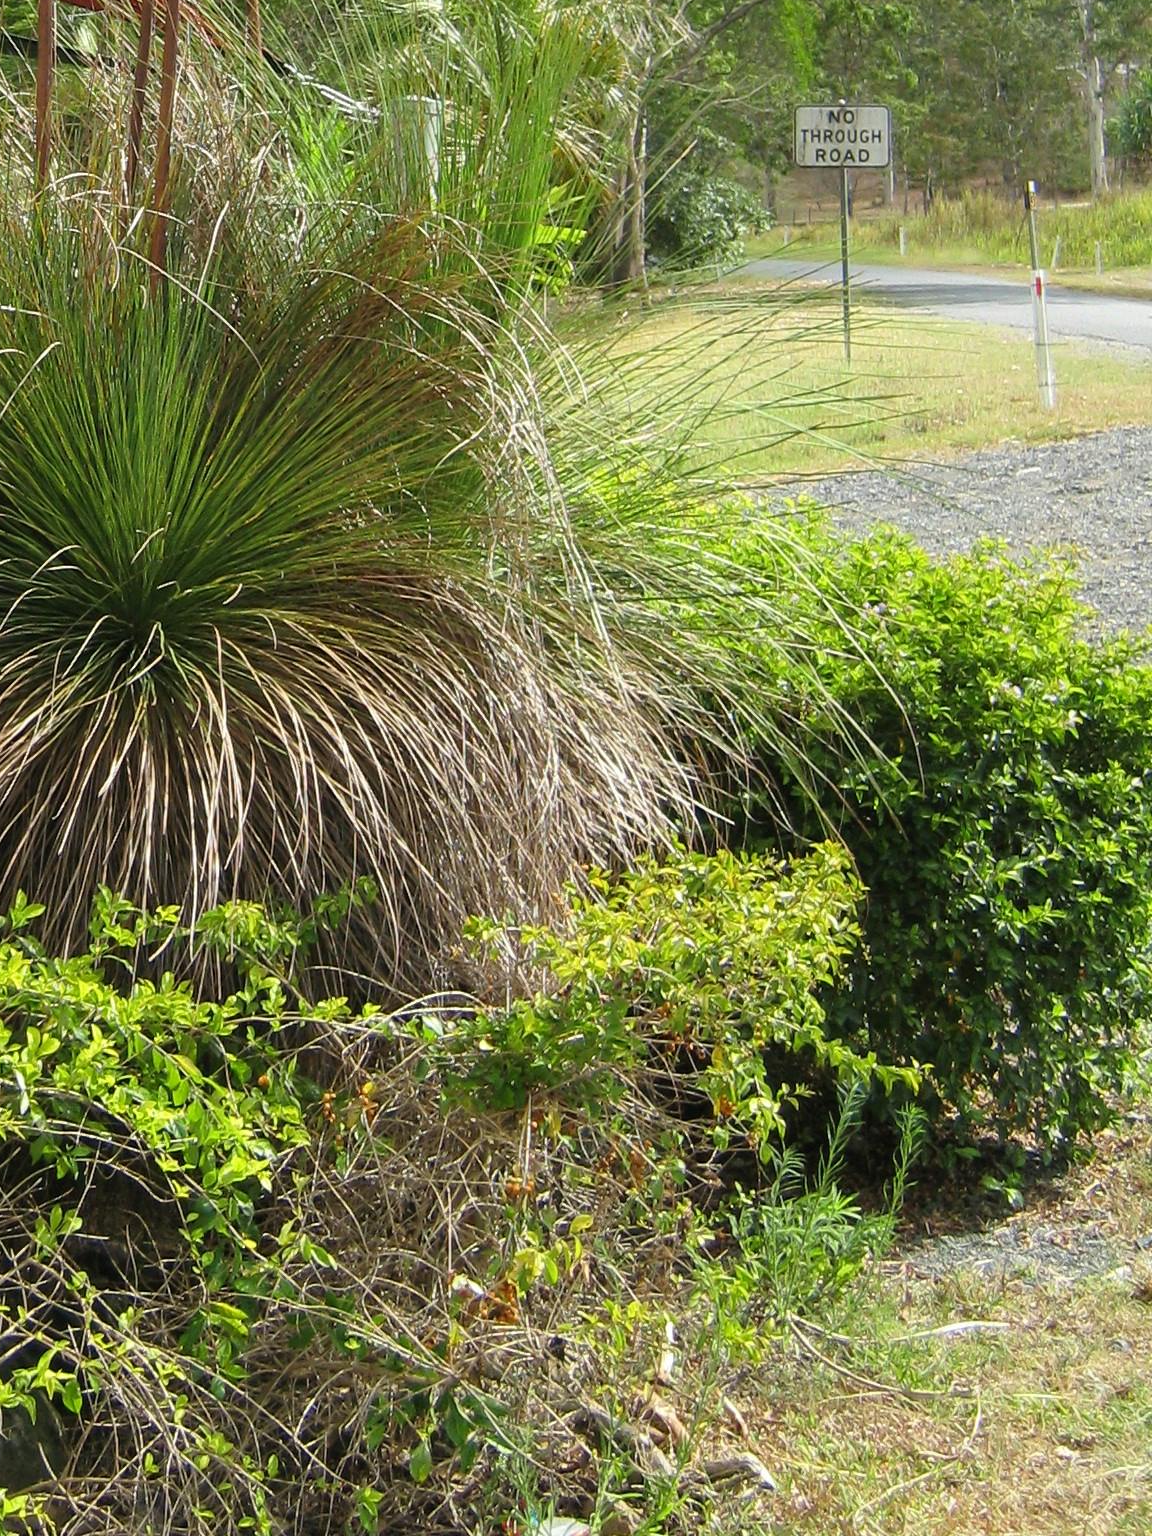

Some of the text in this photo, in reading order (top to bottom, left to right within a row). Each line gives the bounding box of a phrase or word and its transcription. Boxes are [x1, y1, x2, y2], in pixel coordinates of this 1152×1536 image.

[828, 110, 855, 124] NO
[801, 129, 882, 144] THROUGH
[816, 149, 870, 162] ROAD
